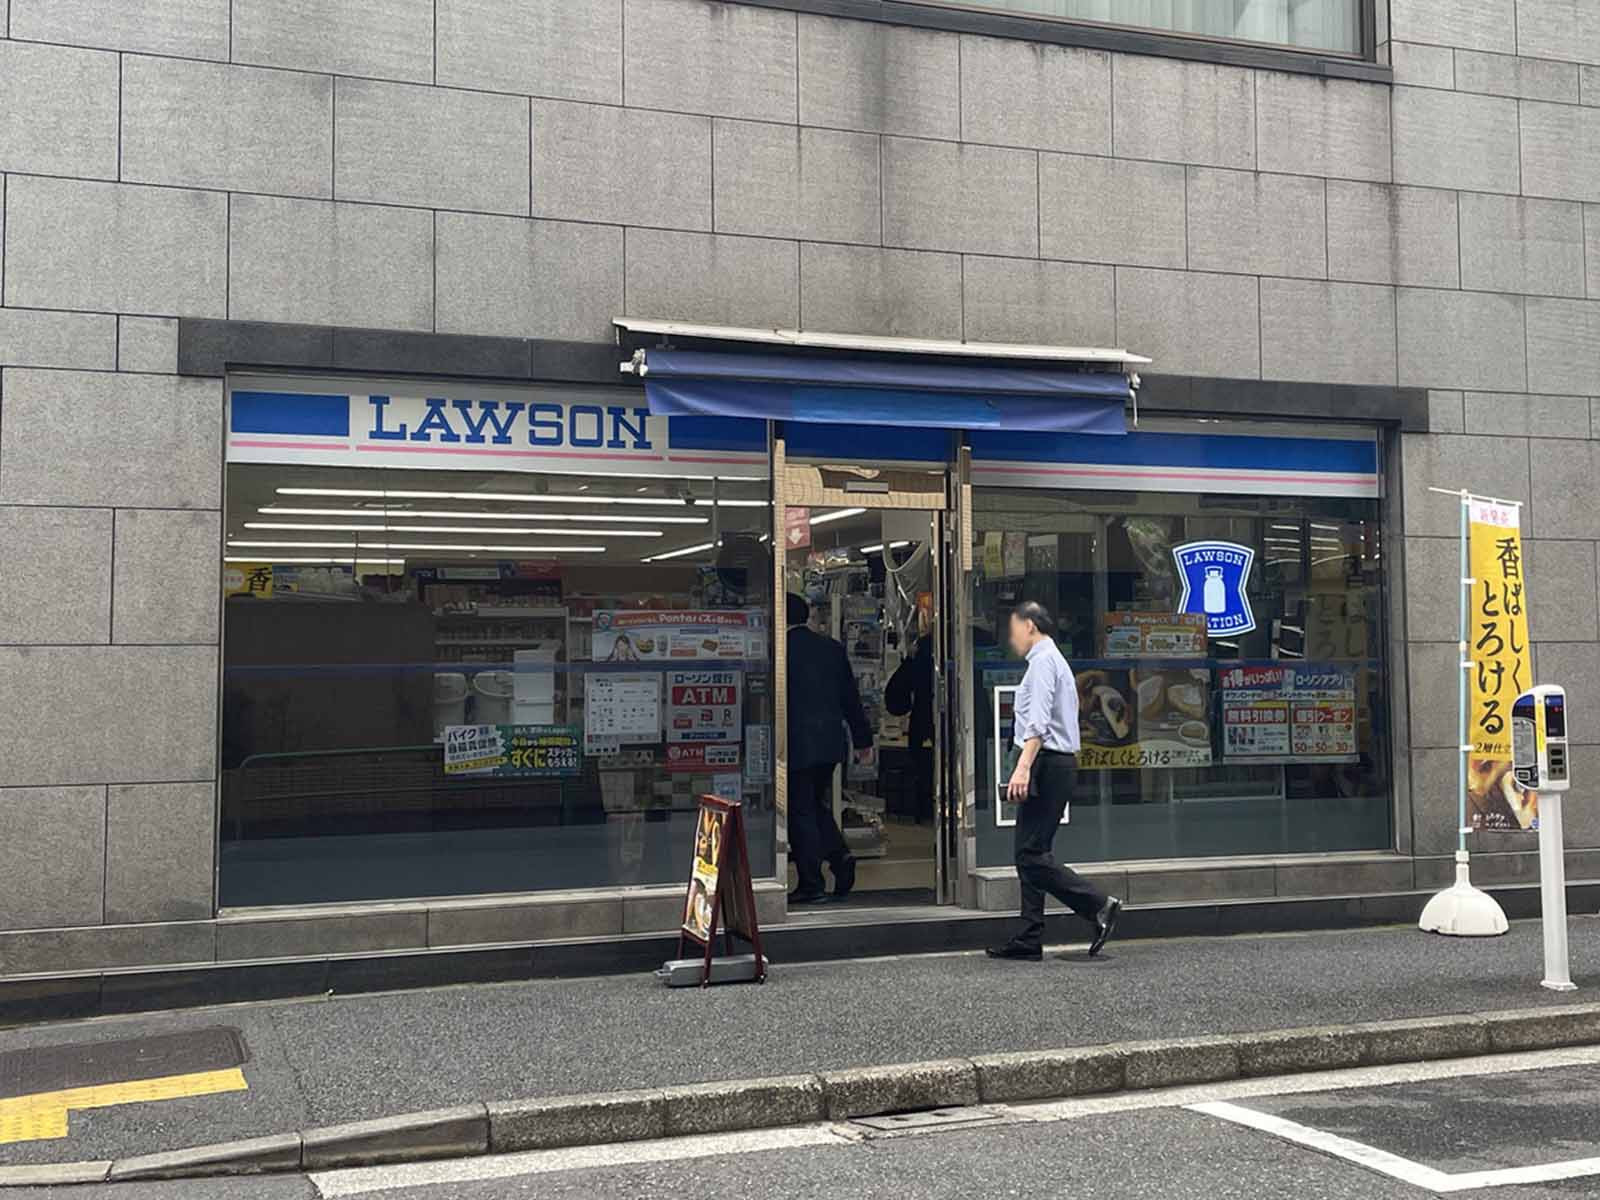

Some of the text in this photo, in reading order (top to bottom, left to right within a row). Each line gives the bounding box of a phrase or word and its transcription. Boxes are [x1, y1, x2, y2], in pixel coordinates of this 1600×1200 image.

[369, 395, 653, 450] LAWSON
[1183, 550, 1244, 566] LAWSON
[247, 567, 272, 592] 香
[1495, 537, 1523, 695] 香ばしく
[1476, 579, 1504, 735] とろける
[682, 688, 728, 704] ATM
[511, 748, 546, 768] すぐに
[682, 748, 704, 757] ATM
